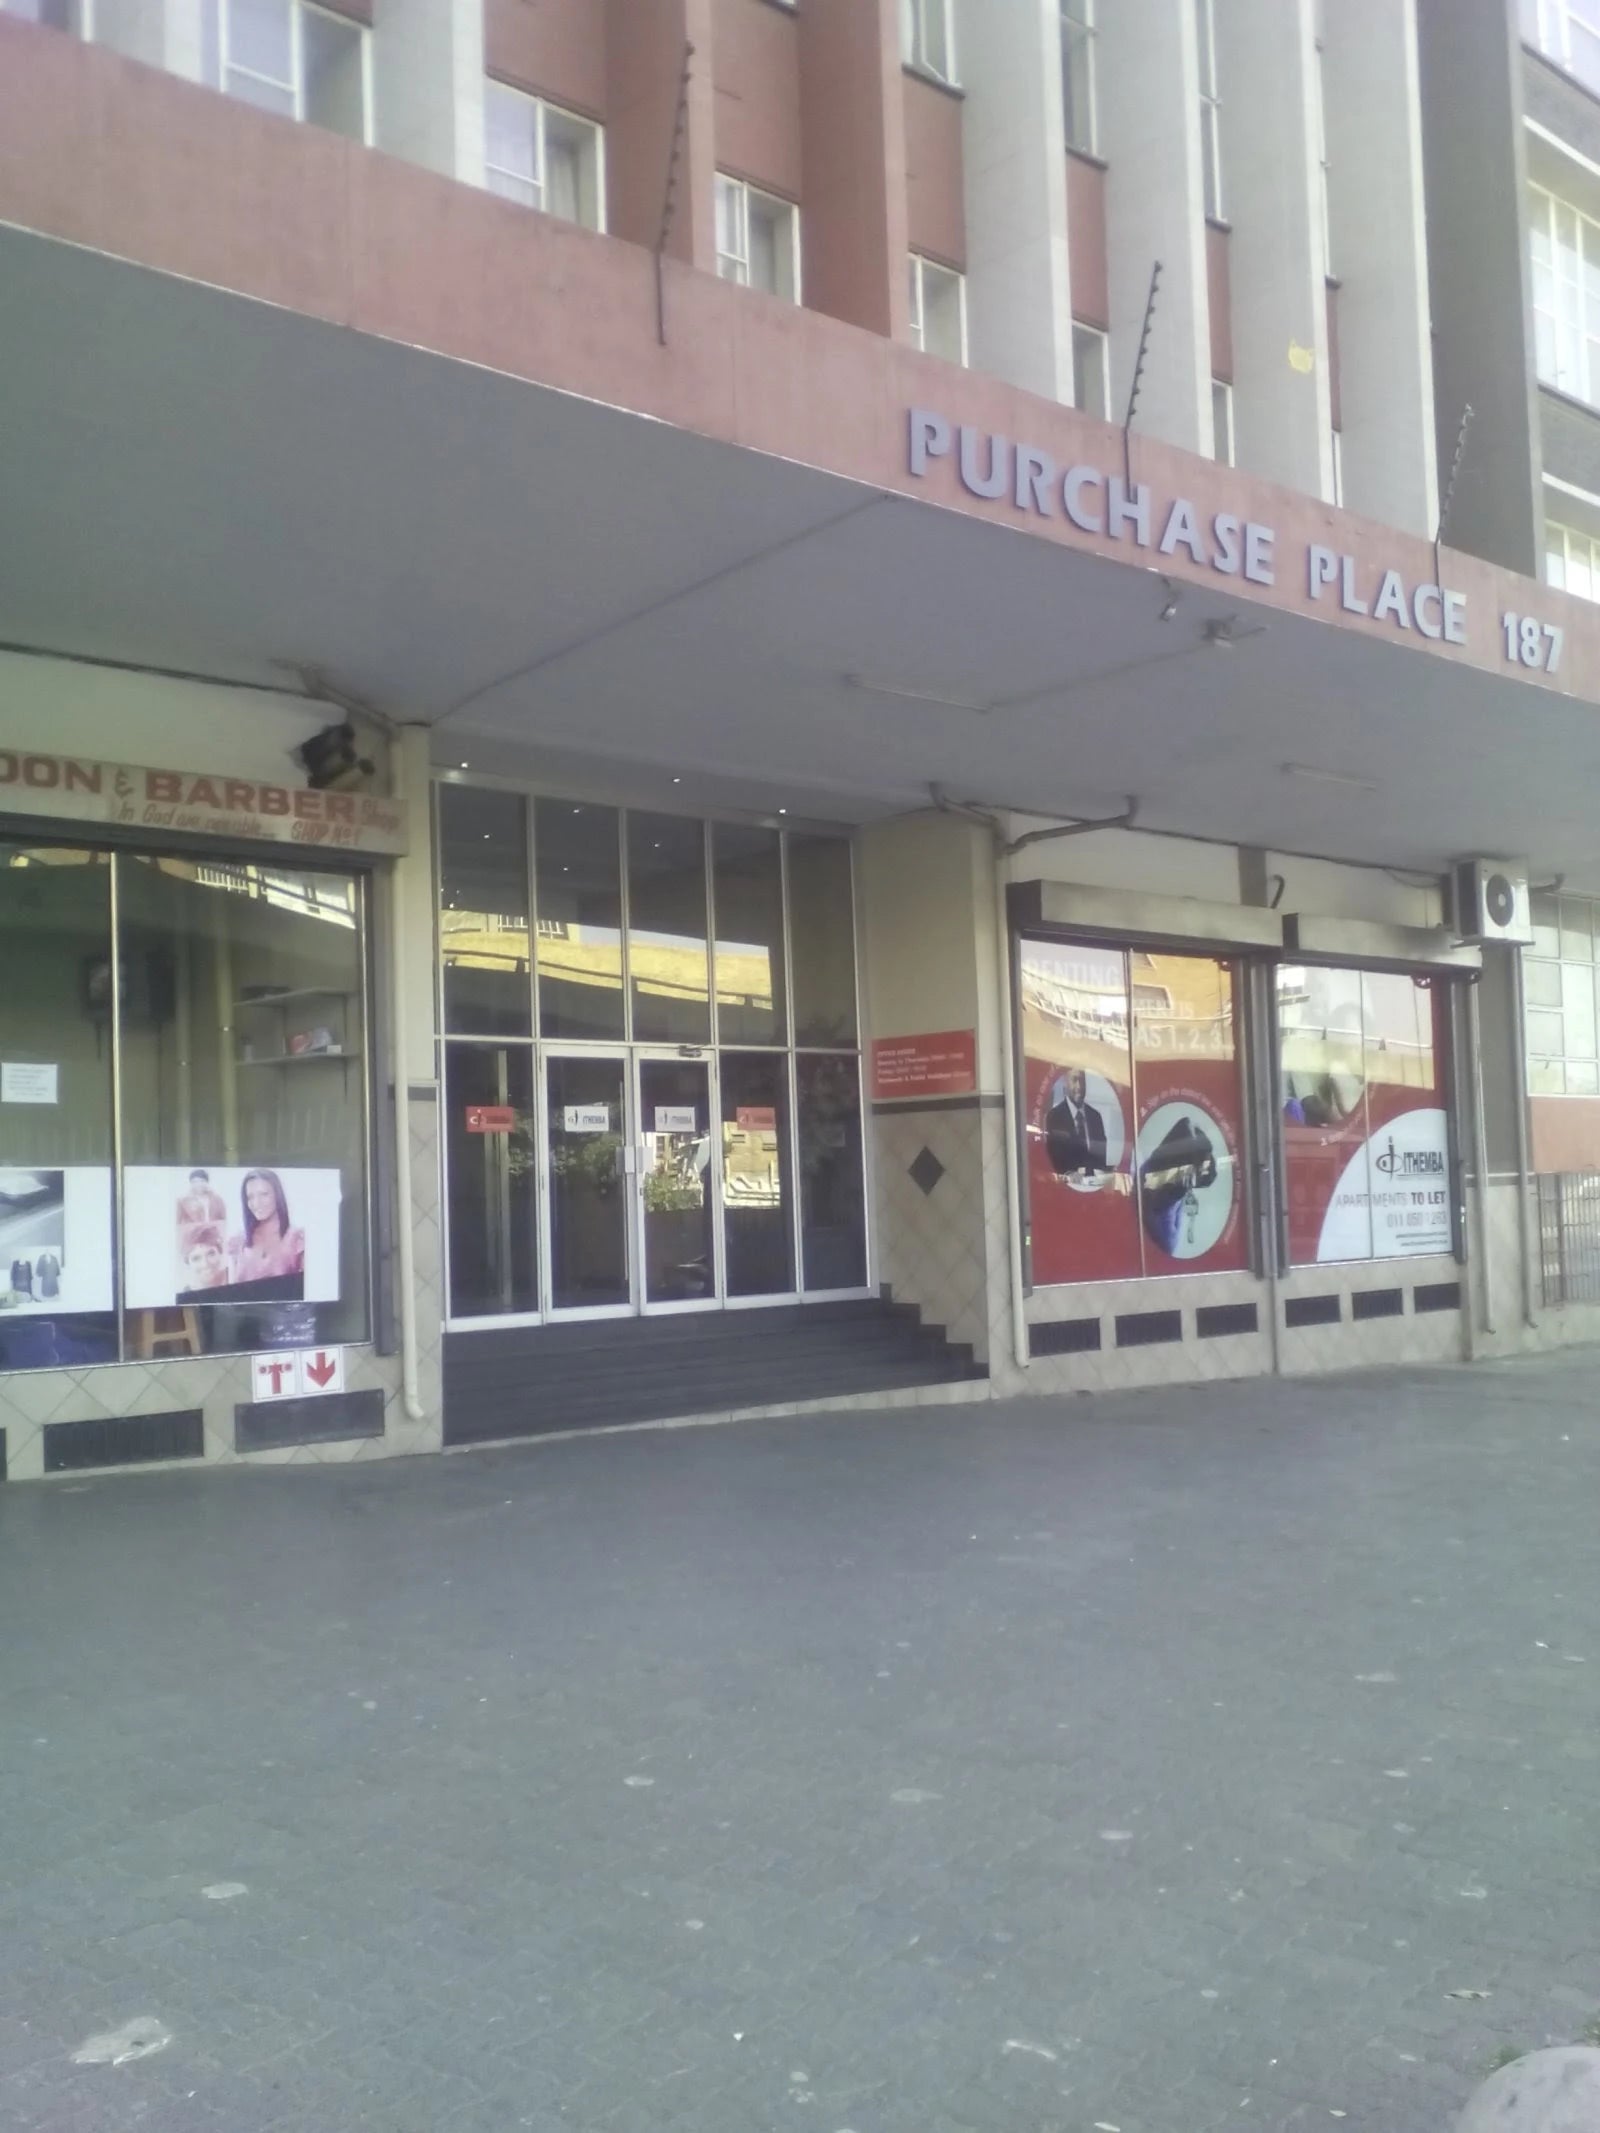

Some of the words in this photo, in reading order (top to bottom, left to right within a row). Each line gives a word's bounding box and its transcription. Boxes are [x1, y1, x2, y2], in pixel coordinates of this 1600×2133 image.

[908, 407, 1275, 586] PURCHASE
[1309, 543, 1467, 645] PLACE
[1502, 611, 1564, 673] 187
[145, 770, 355, 822] BARBER
[1403, 1152, 1444, 1173] ITHEMBA
[1411, 1192, 1424, 1205] TO
[1428, 1191, 1446, 1204] LET
